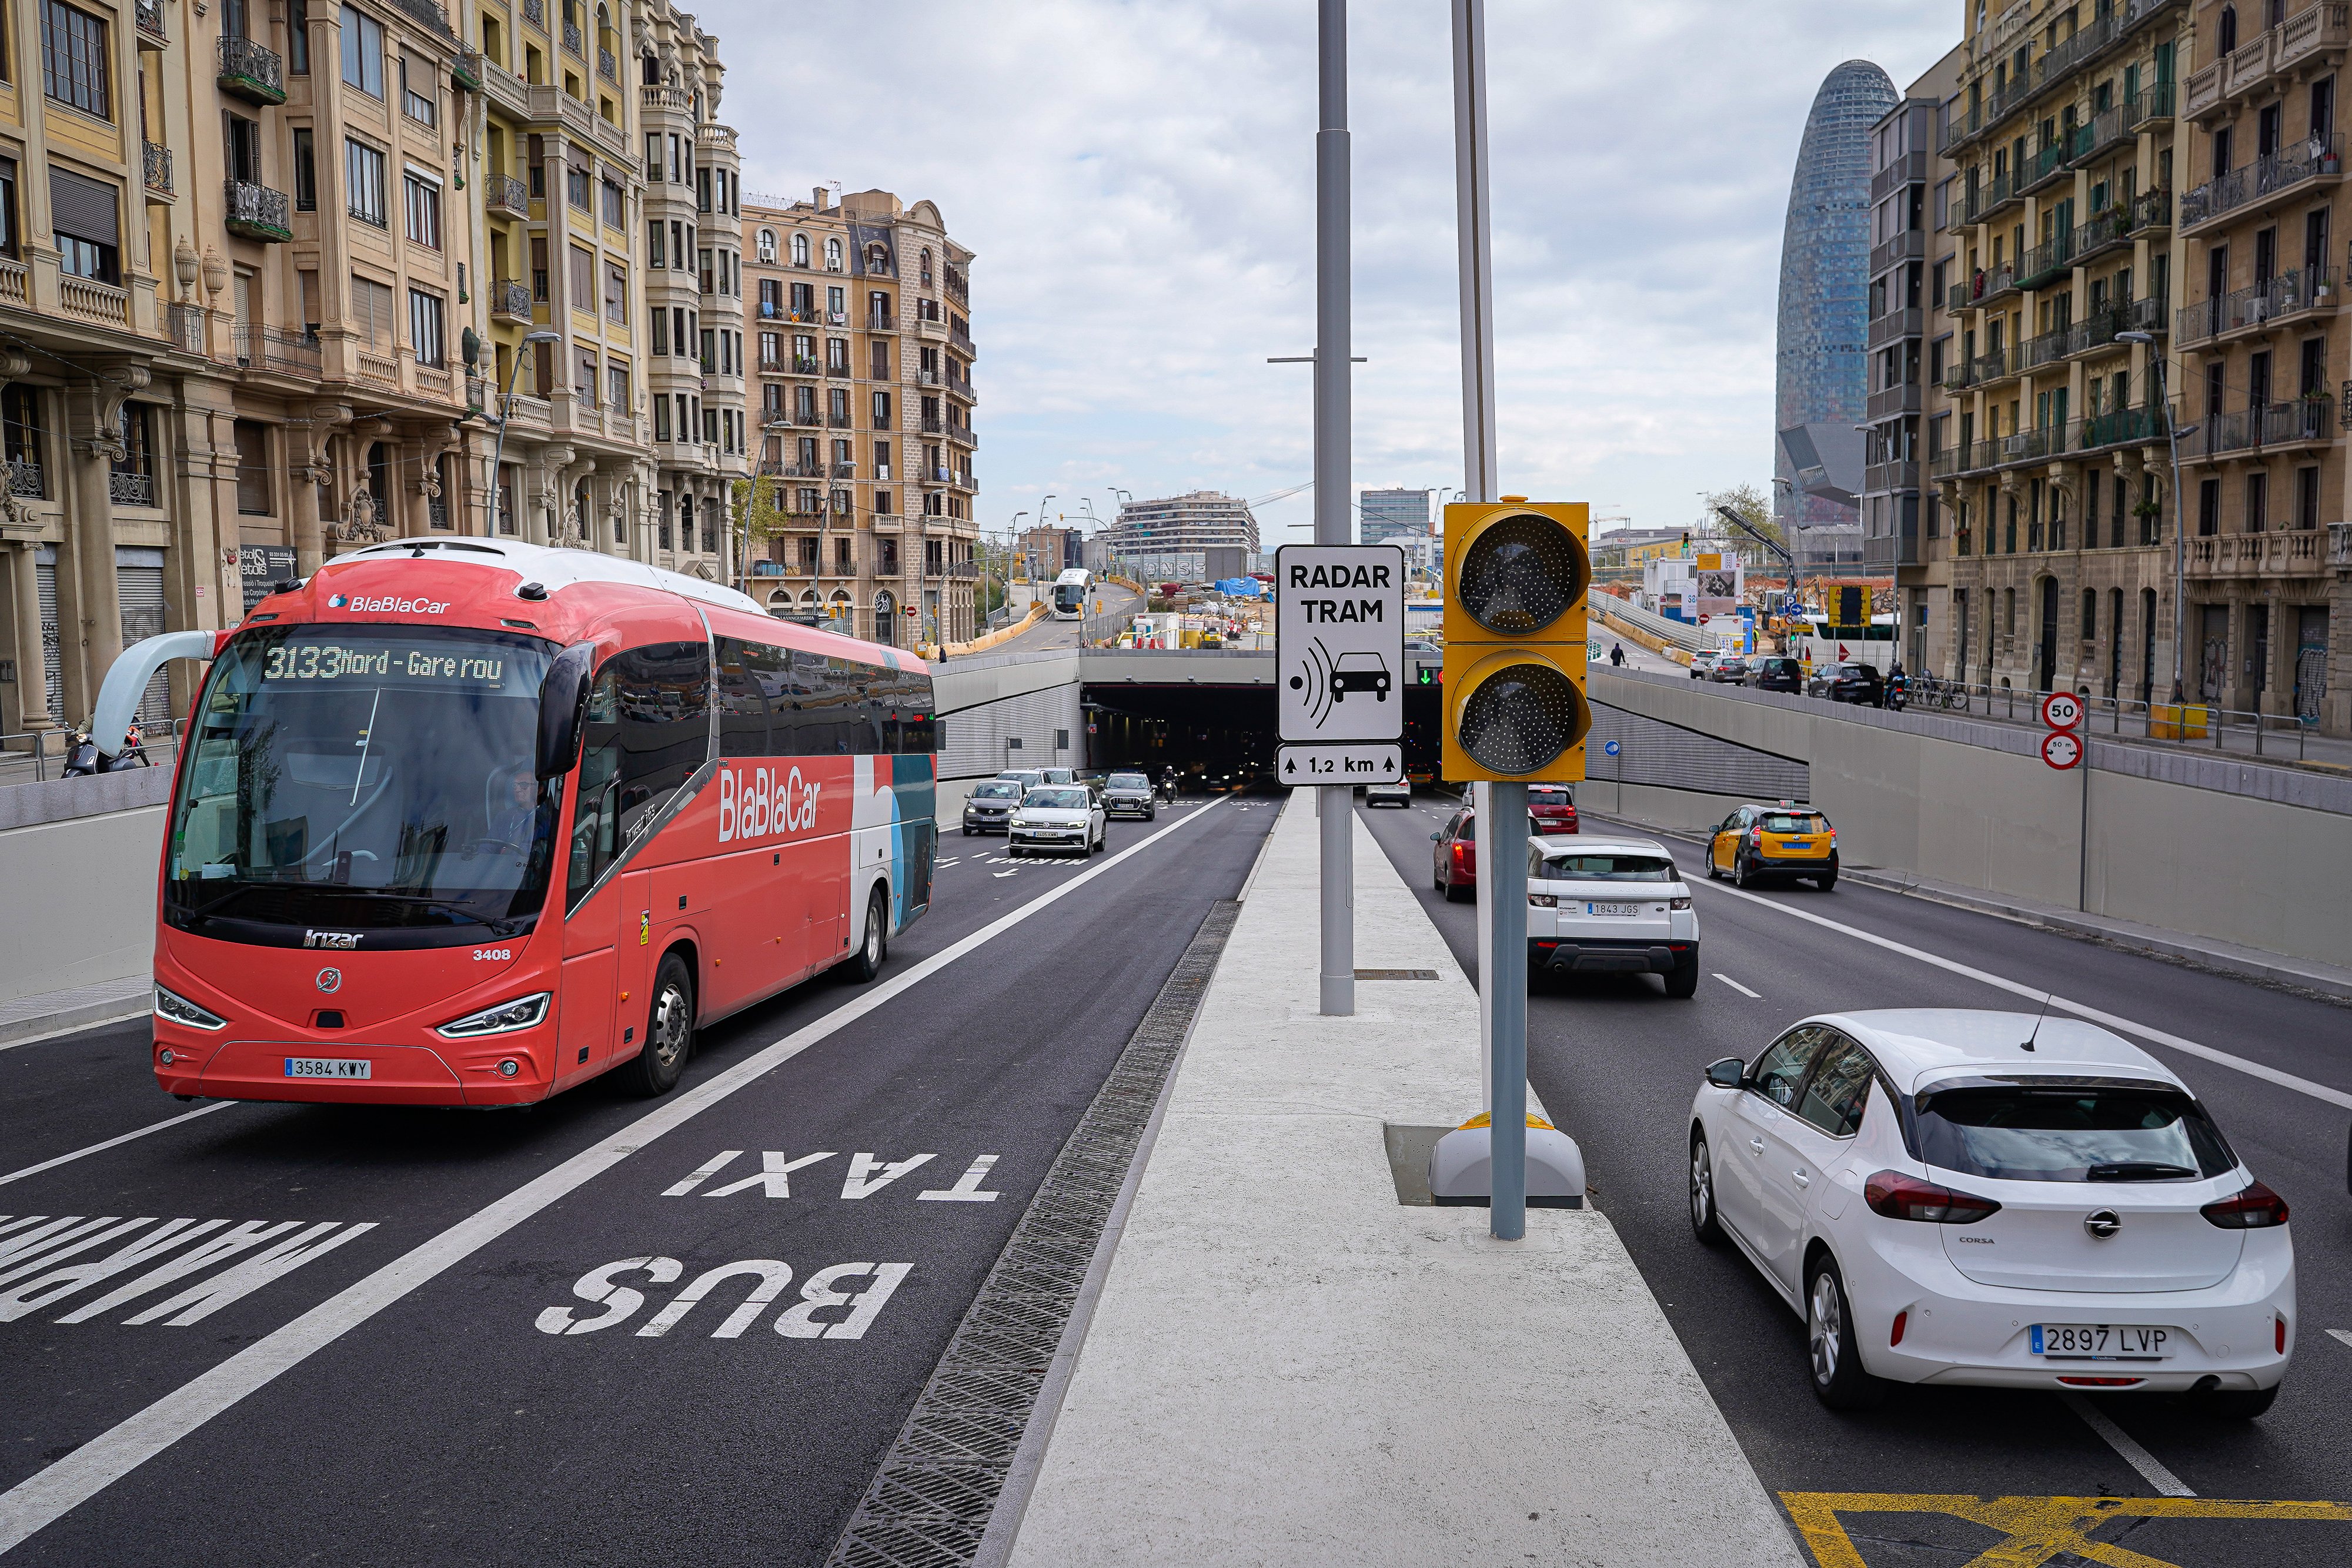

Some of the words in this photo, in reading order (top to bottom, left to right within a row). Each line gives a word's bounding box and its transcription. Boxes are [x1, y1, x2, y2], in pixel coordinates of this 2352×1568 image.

[240, 549, 255, 560] ètol
[241, 563, 267, 576] ètols
[1290, 565, 1391, 589] RADAR
[256, 580, 275, 589] Troquelat
[349, 596, 451, 614] BlaBlaCar
[1786, 596, 1795, 607] P
[1300, 599, 1383, 623] TRAM
[265, 646, 342, 679] 3133
[340, 650, 389, 675] Nord
[407, 651, 456, 677] Gare
[2052, 705, 2074, 718] 50
[1308, 757, 1334, 774] 1,2
[1345, 756, 1374, 773] km
[719, 765, 821, 843] BlaBlaCar
[985, 857, 1090, 865] MARINA
[1595, 904, 1618, 914] 1843
[1621, 905, 1638, 914] JGS
[303, 929, 365, 949] Irizar
[473, 949, 511, 961] 3408
[295, 1060, 333, 1076] 3584
[338, 1061, 368, 1077] KWY
[660, 1149, 1001, 1202] TAXI
[0, 1215, 381, 1327] MARI
[534, 1255, 915, 1340] BUS
[2046, 1328, 2110, 1352] 2897
[2119, 1329, 2167, 1352] LVP
